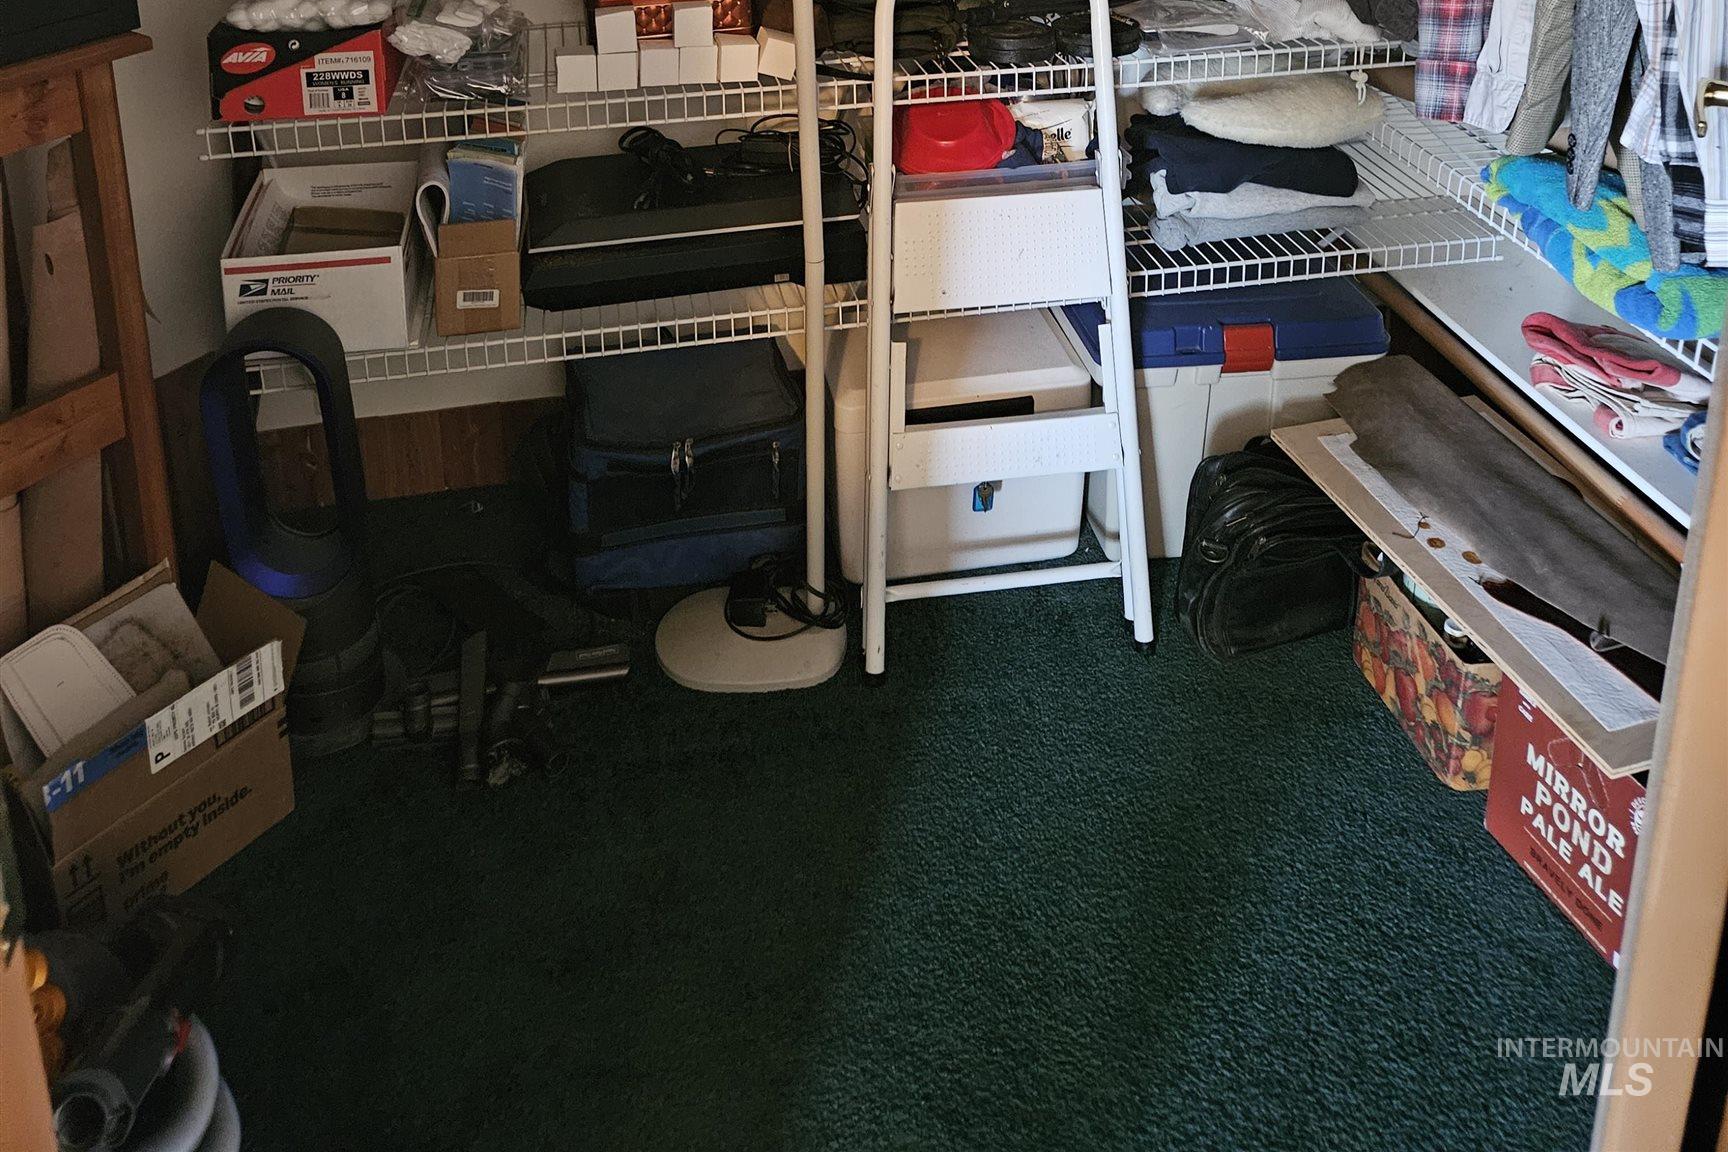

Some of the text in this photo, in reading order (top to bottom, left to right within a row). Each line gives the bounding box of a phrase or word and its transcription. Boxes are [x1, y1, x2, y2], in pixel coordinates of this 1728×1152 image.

[312, 71, 363, 81] 228WWDS
[341, 91, 346, 99] 8
[270, 288, 295, 296] MAIL
[272, 275, 316, 285] PRIORITY
[117, 793, 221, 866] Without you,
[149, 823, 200, 864] empty
[202, 786, 253, 826] inside.
[1525, 742, 1626, 860] MIRROR
[1533, 780, 1612, 876] POND
[1518, 794, 1623, 918] PALE ALE
